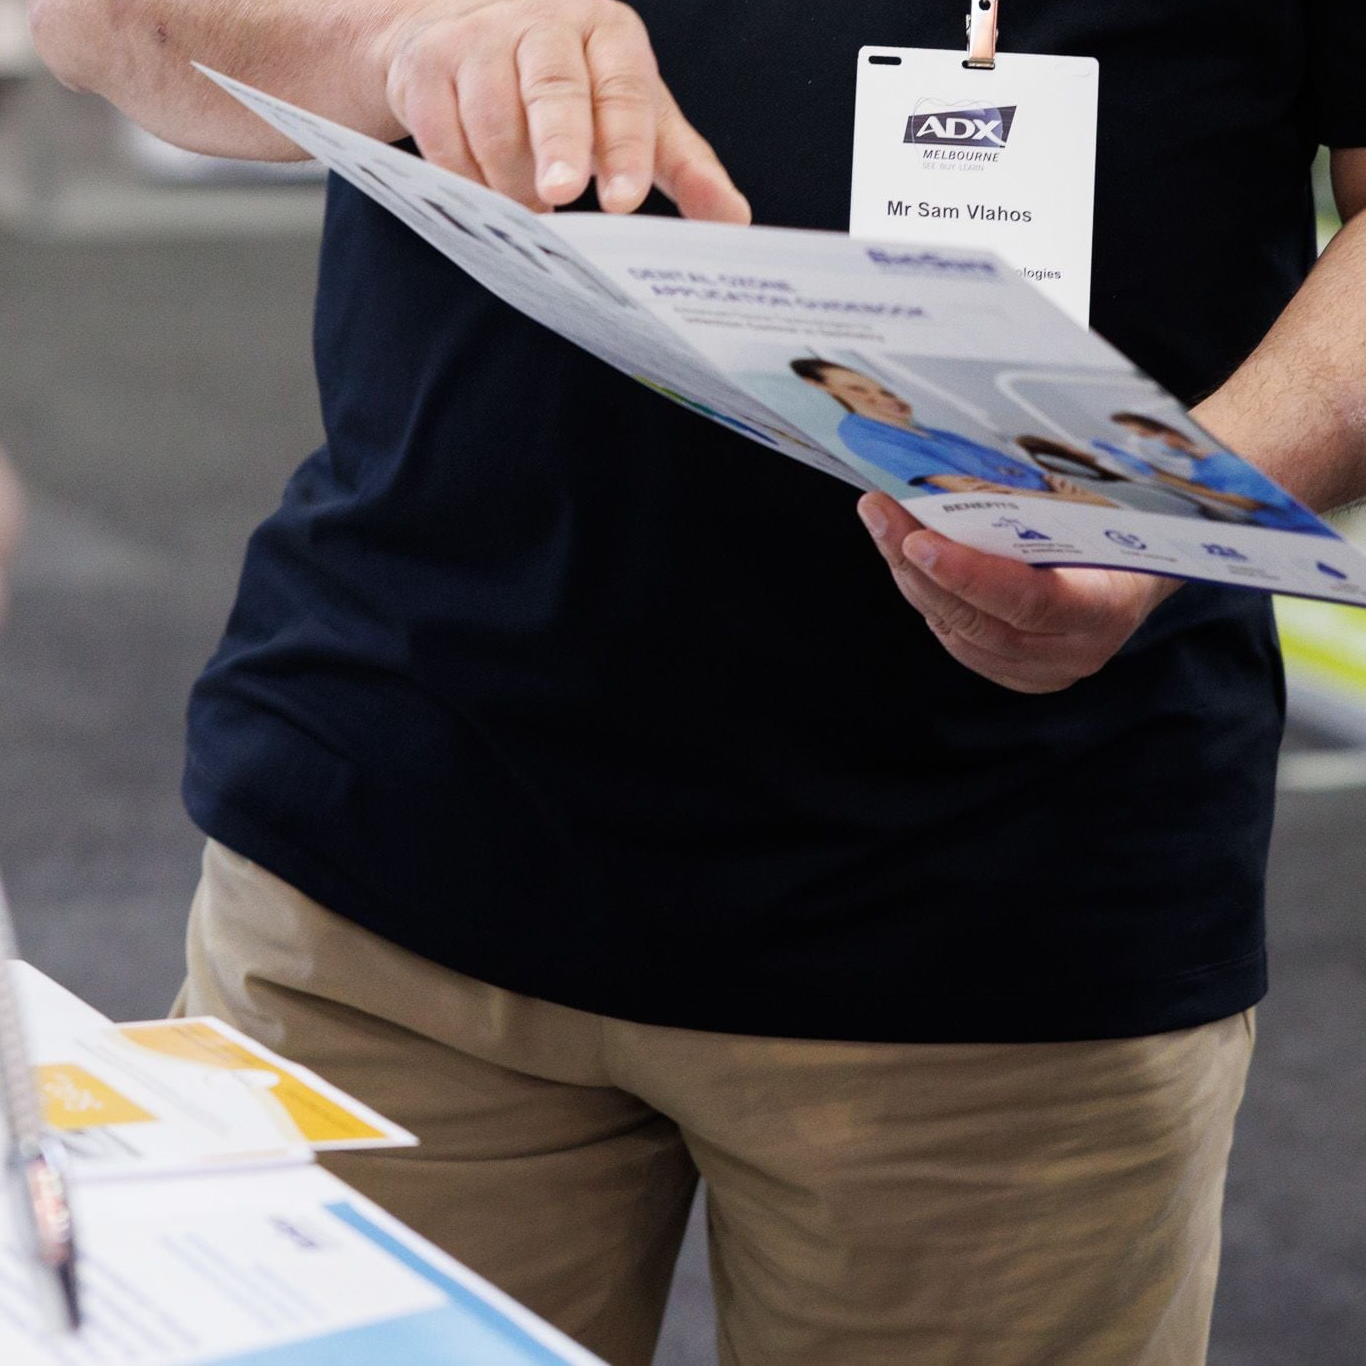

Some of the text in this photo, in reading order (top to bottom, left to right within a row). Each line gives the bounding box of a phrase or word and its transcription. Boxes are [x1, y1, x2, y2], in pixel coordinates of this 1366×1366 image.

[915, 115, 1007, 146] ADX
[922, 148, 1001, 162] MELBOURNE
[922, 161, 937, 171] SEE
[886, 200, 1033, 223] Mr Sam Vlahos
[941, 501, 1021, 513] BENEFITS
